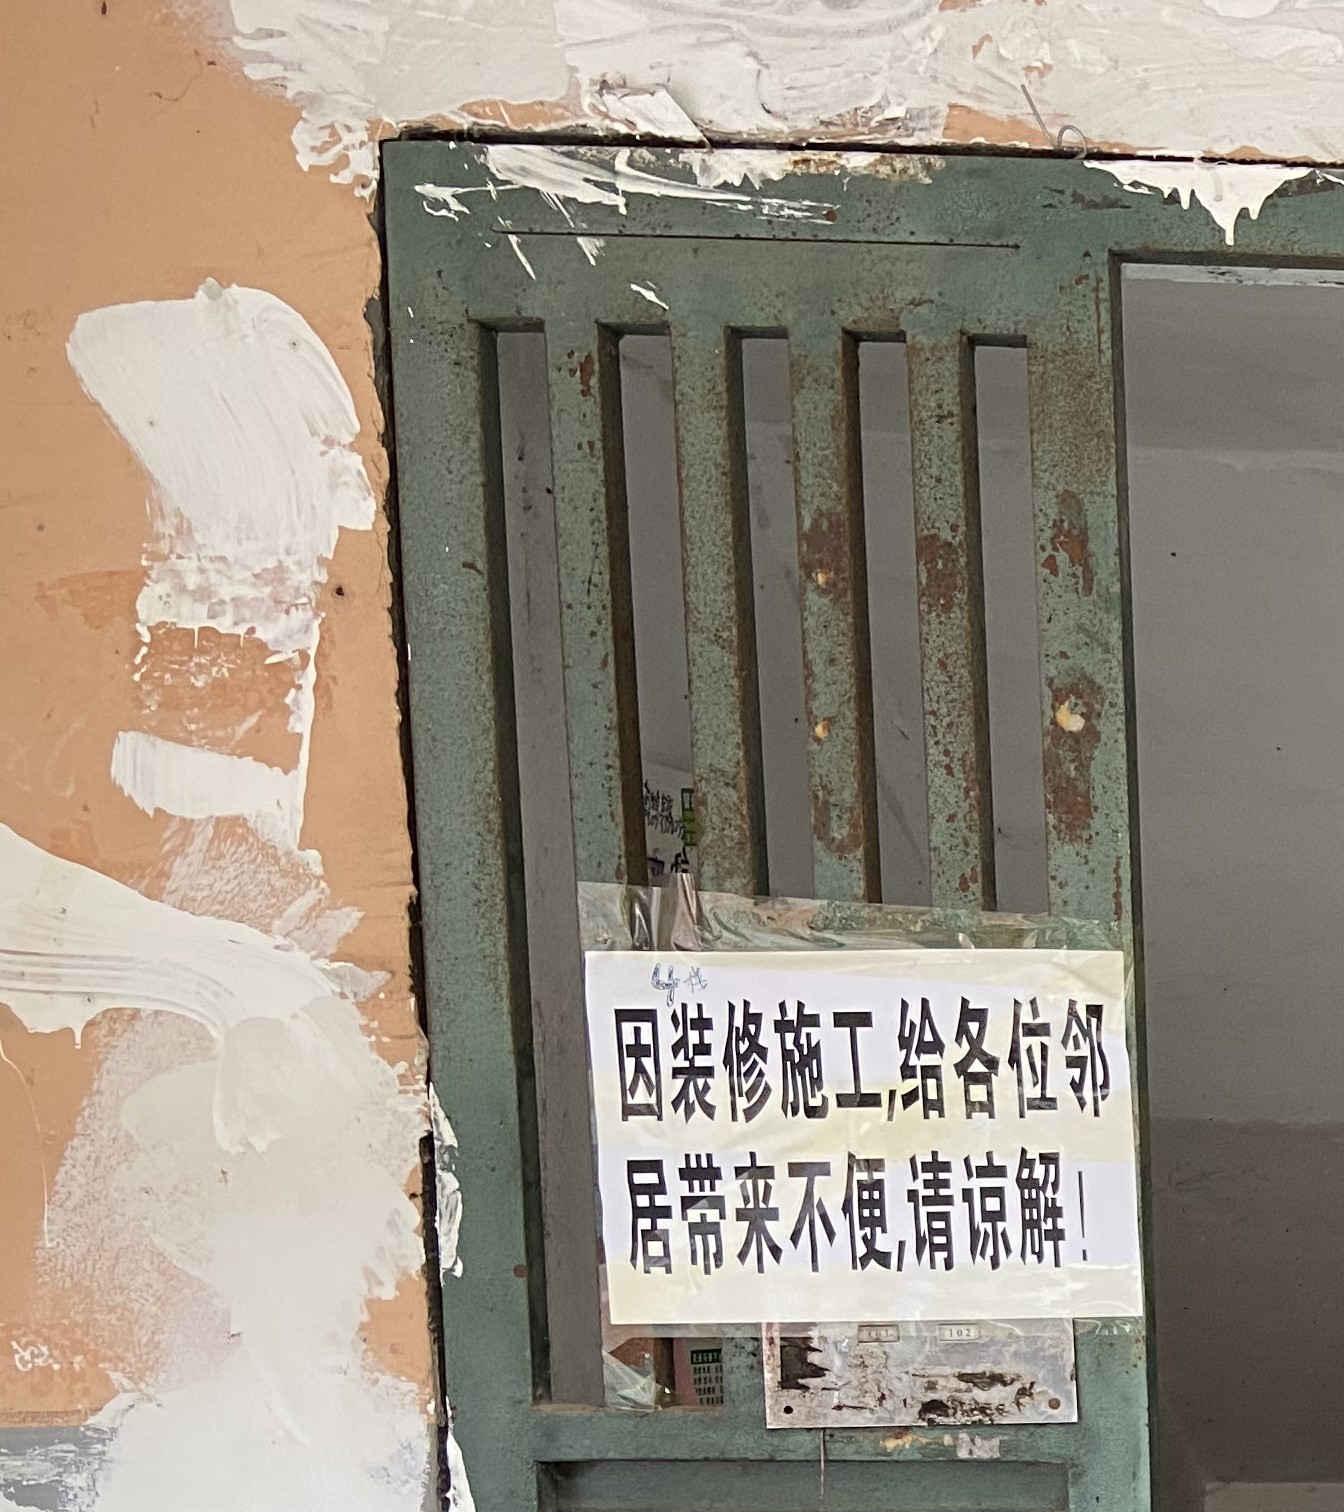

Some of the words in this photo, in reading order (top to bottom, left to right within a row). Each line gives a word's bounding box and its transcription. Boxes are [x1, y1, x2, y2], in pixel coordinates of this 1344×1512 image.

[614, 996, 1111, 1123] 因装修施工,给各位邻
[625, 1146, 1089, 1276] 居带来不便,请谅解!
[949, 1328, 971, 1338] 102
